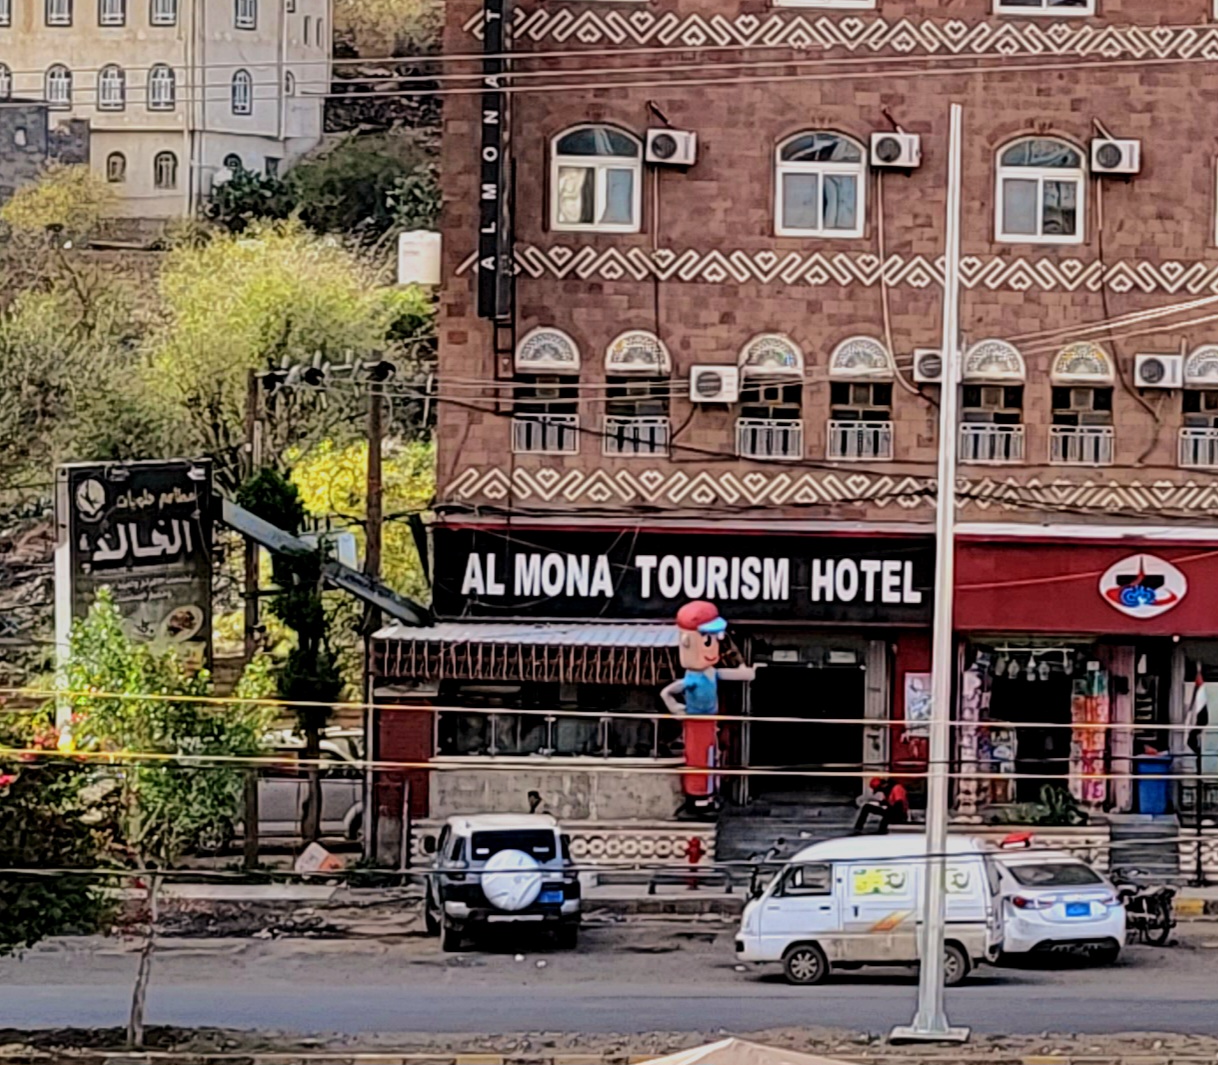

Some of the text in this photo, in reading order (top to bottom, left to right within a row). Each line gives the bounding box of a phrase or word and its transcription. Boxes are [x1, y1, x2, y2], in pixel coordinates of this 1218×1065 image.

[461, 553, 922, 603] AL MONA TOURISM HOTEL
